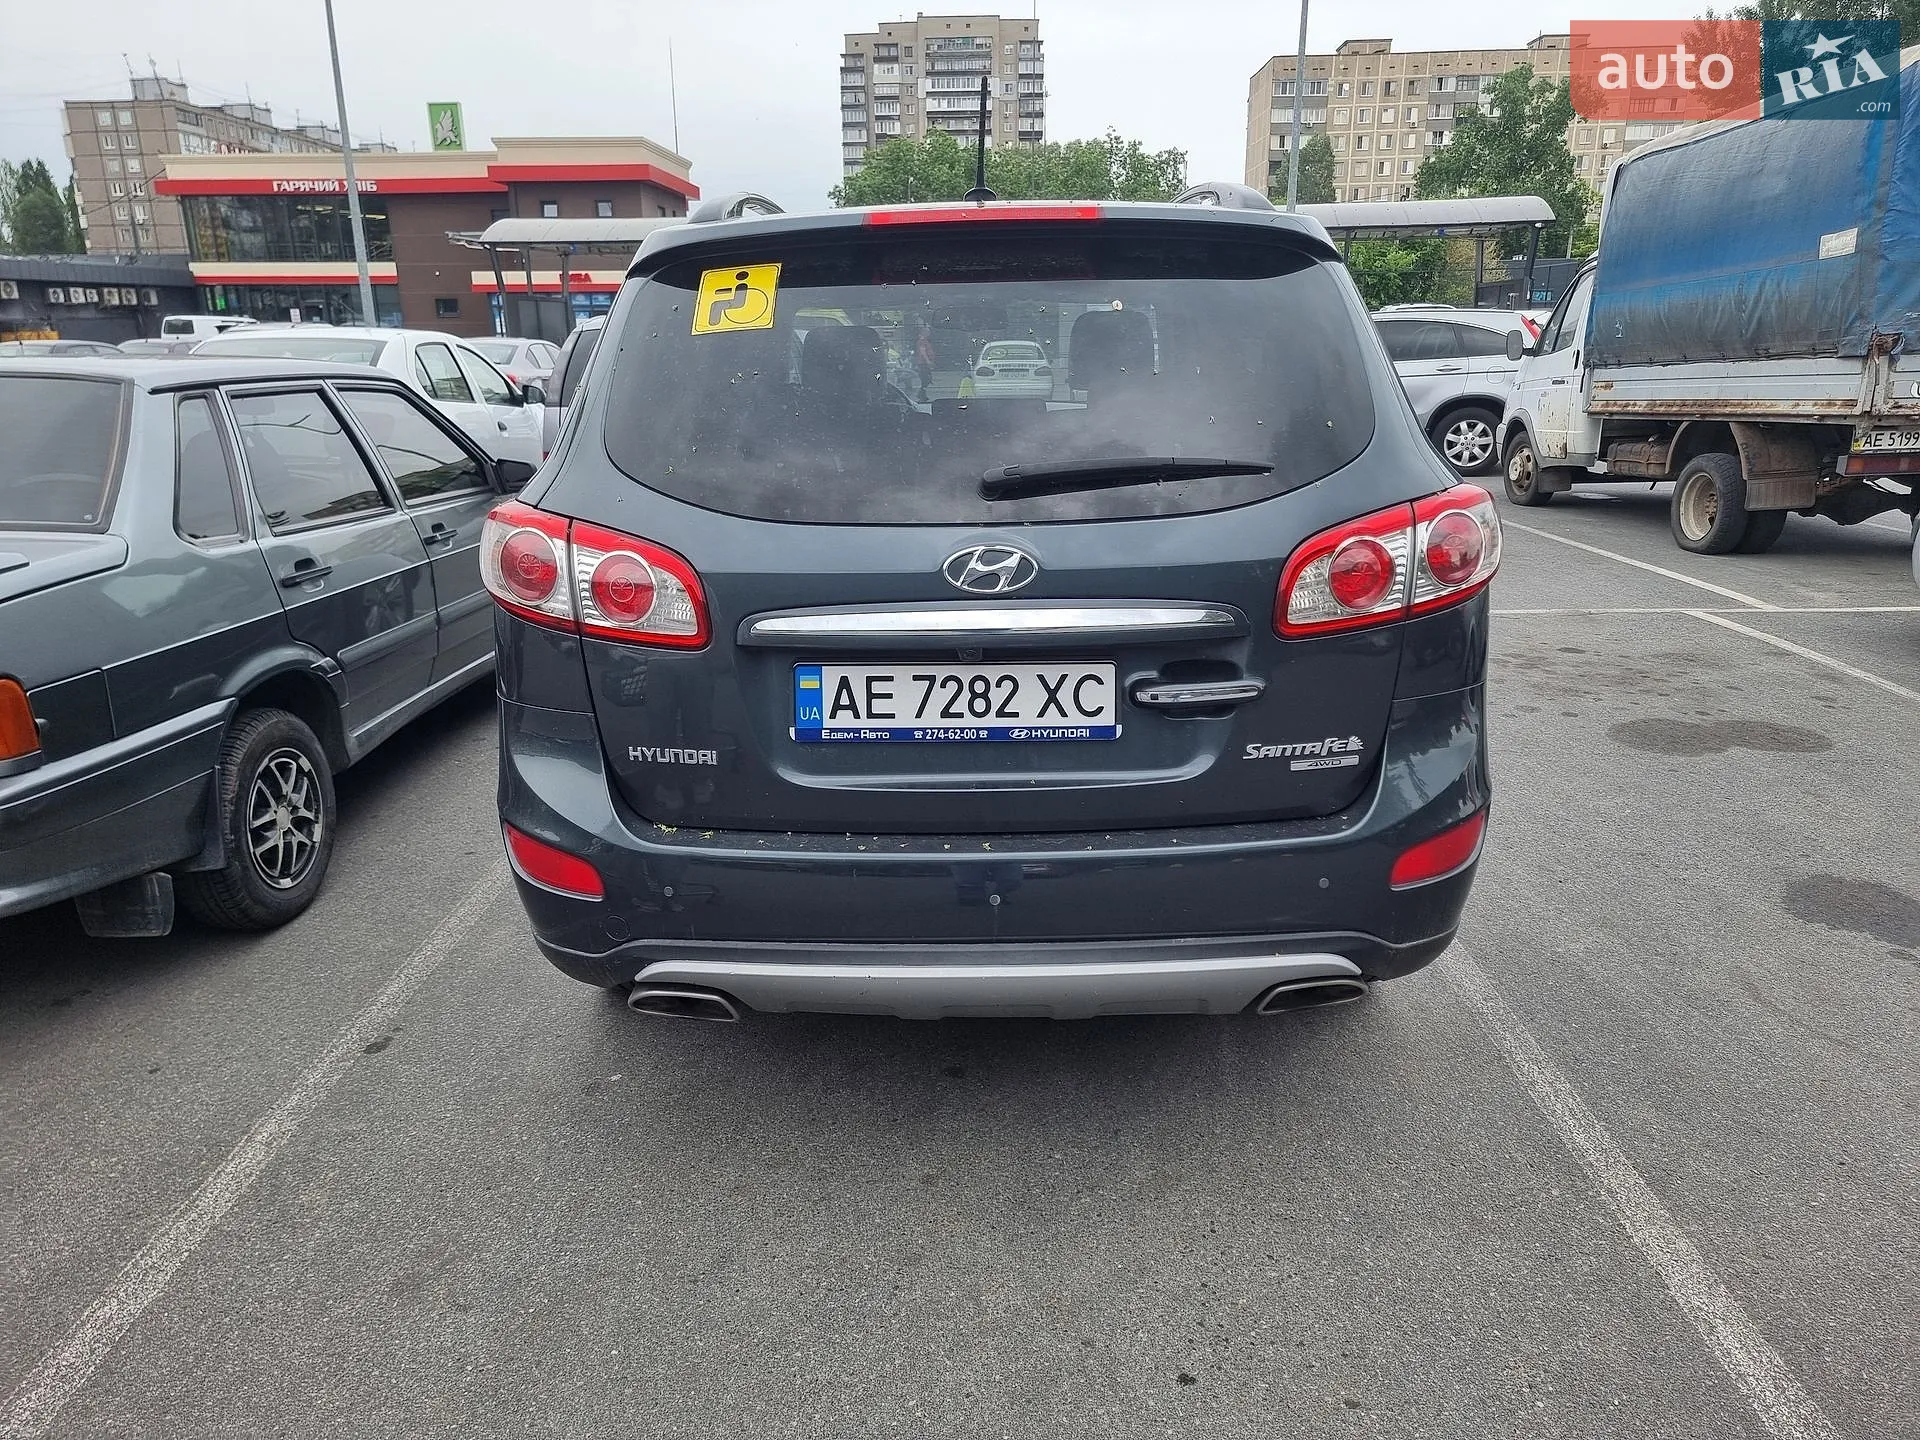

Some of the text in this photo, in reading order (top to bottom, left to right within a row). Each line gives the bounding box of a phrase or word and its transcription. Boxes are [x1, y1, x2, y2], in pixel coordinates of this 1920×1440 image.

[272, 179, 340, 193] ГАРЯЧИЙ
[1863, 431, 1920, 448] AE 5199
[828, 673, 1105, 720] AE 7282 XC
[800, 706, 821, 720] UA
[925, 729, 977, 740] 274-62-00
[1031, 728, 1090, 738] HYUNDAI
[627, 746, 718, 766] HYUNDAI
[1307, 759, 1342, 768] 4WD
